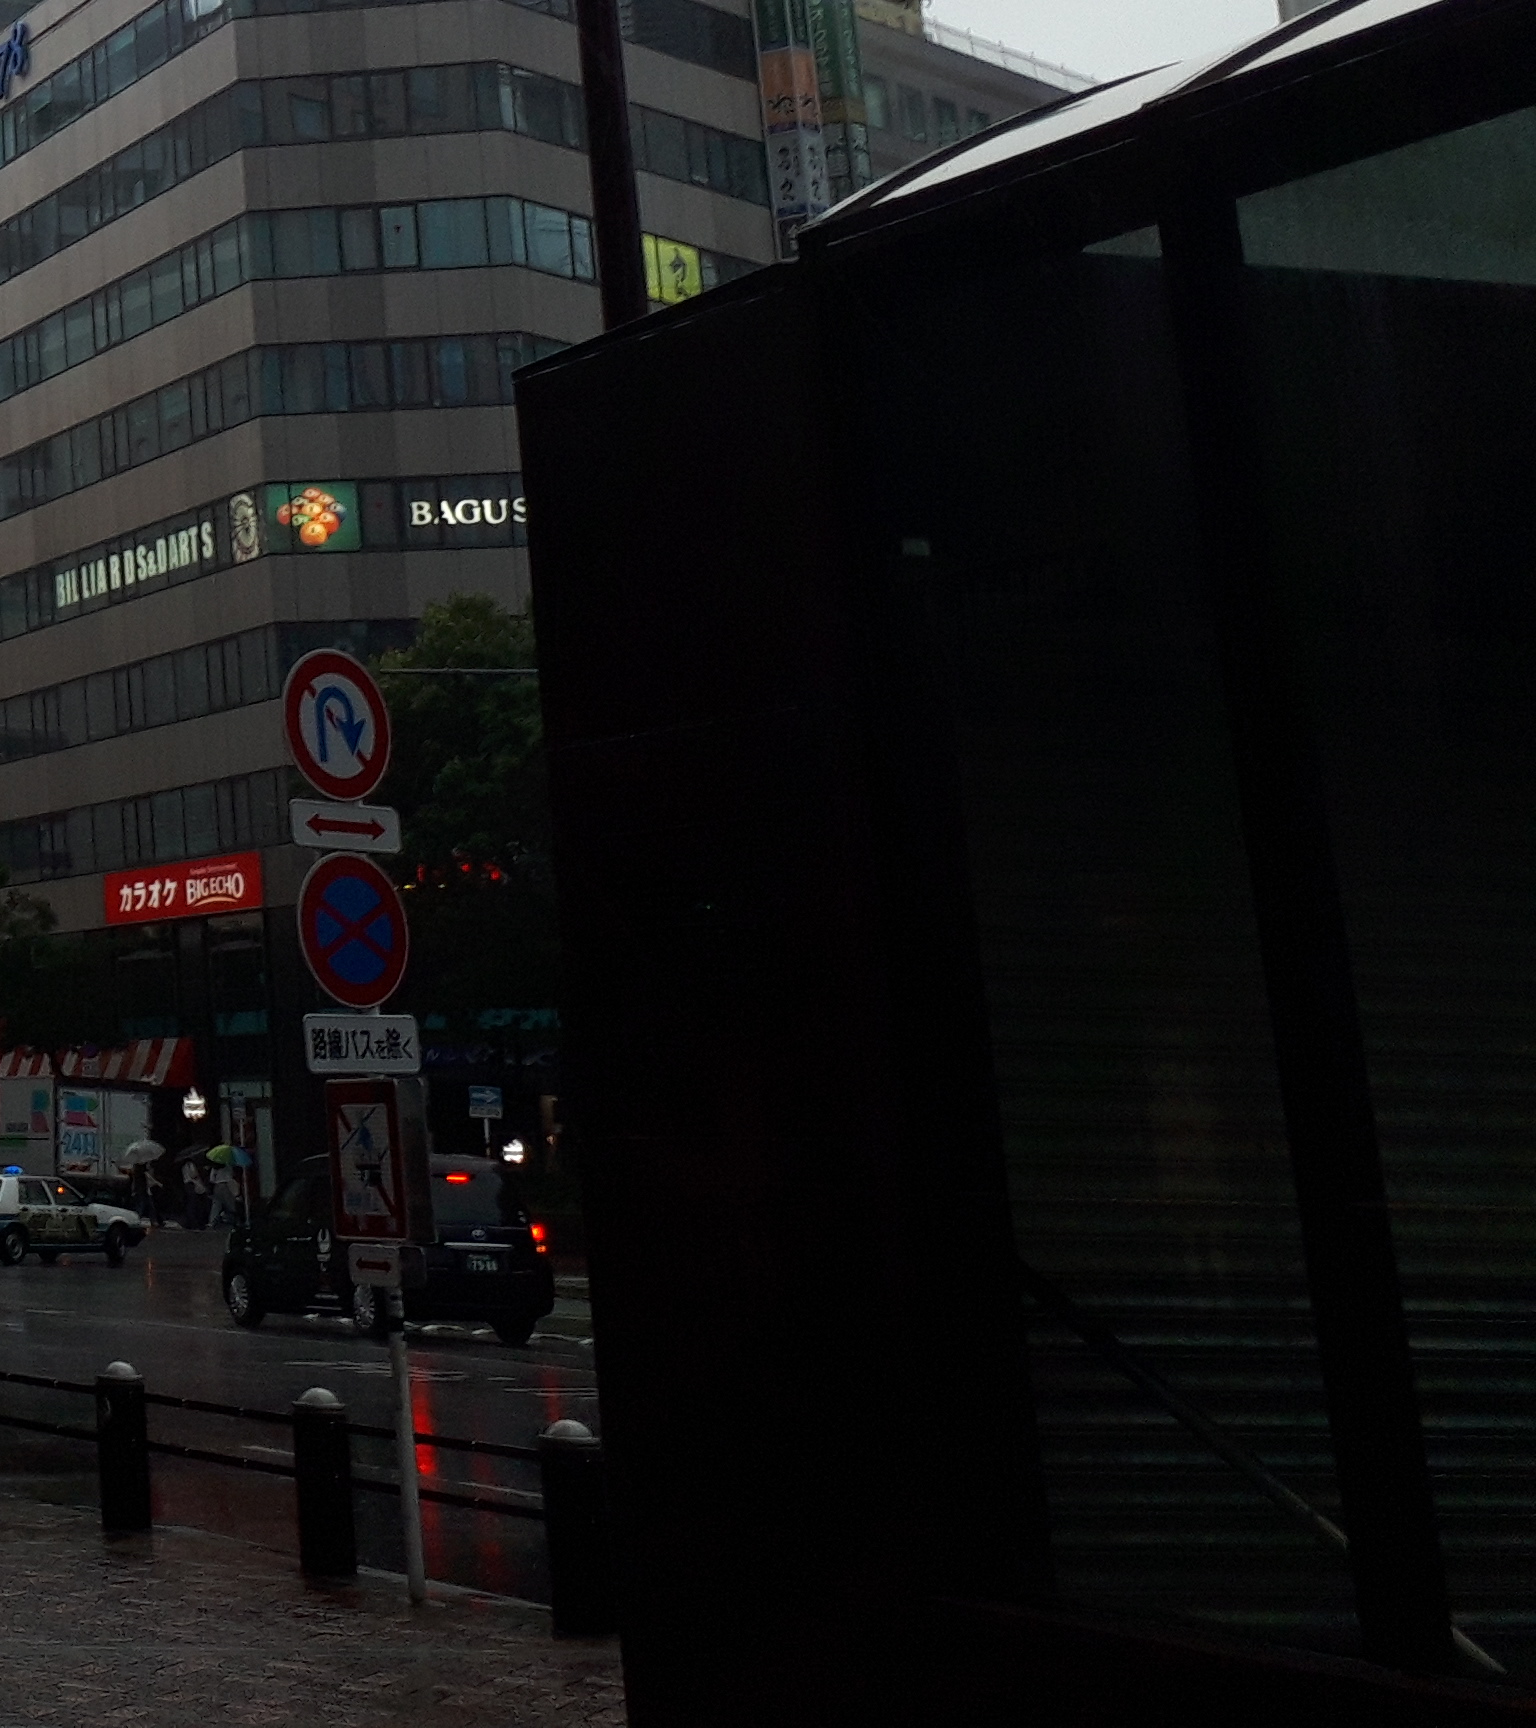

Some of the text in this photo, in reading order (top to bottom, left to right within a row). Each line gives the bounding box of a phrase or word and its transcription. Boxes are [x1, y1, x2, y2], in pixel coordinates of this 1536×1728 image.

[409, 495, 527, 526] BAGUS
[118, 877, 178, 914] カラオケ
